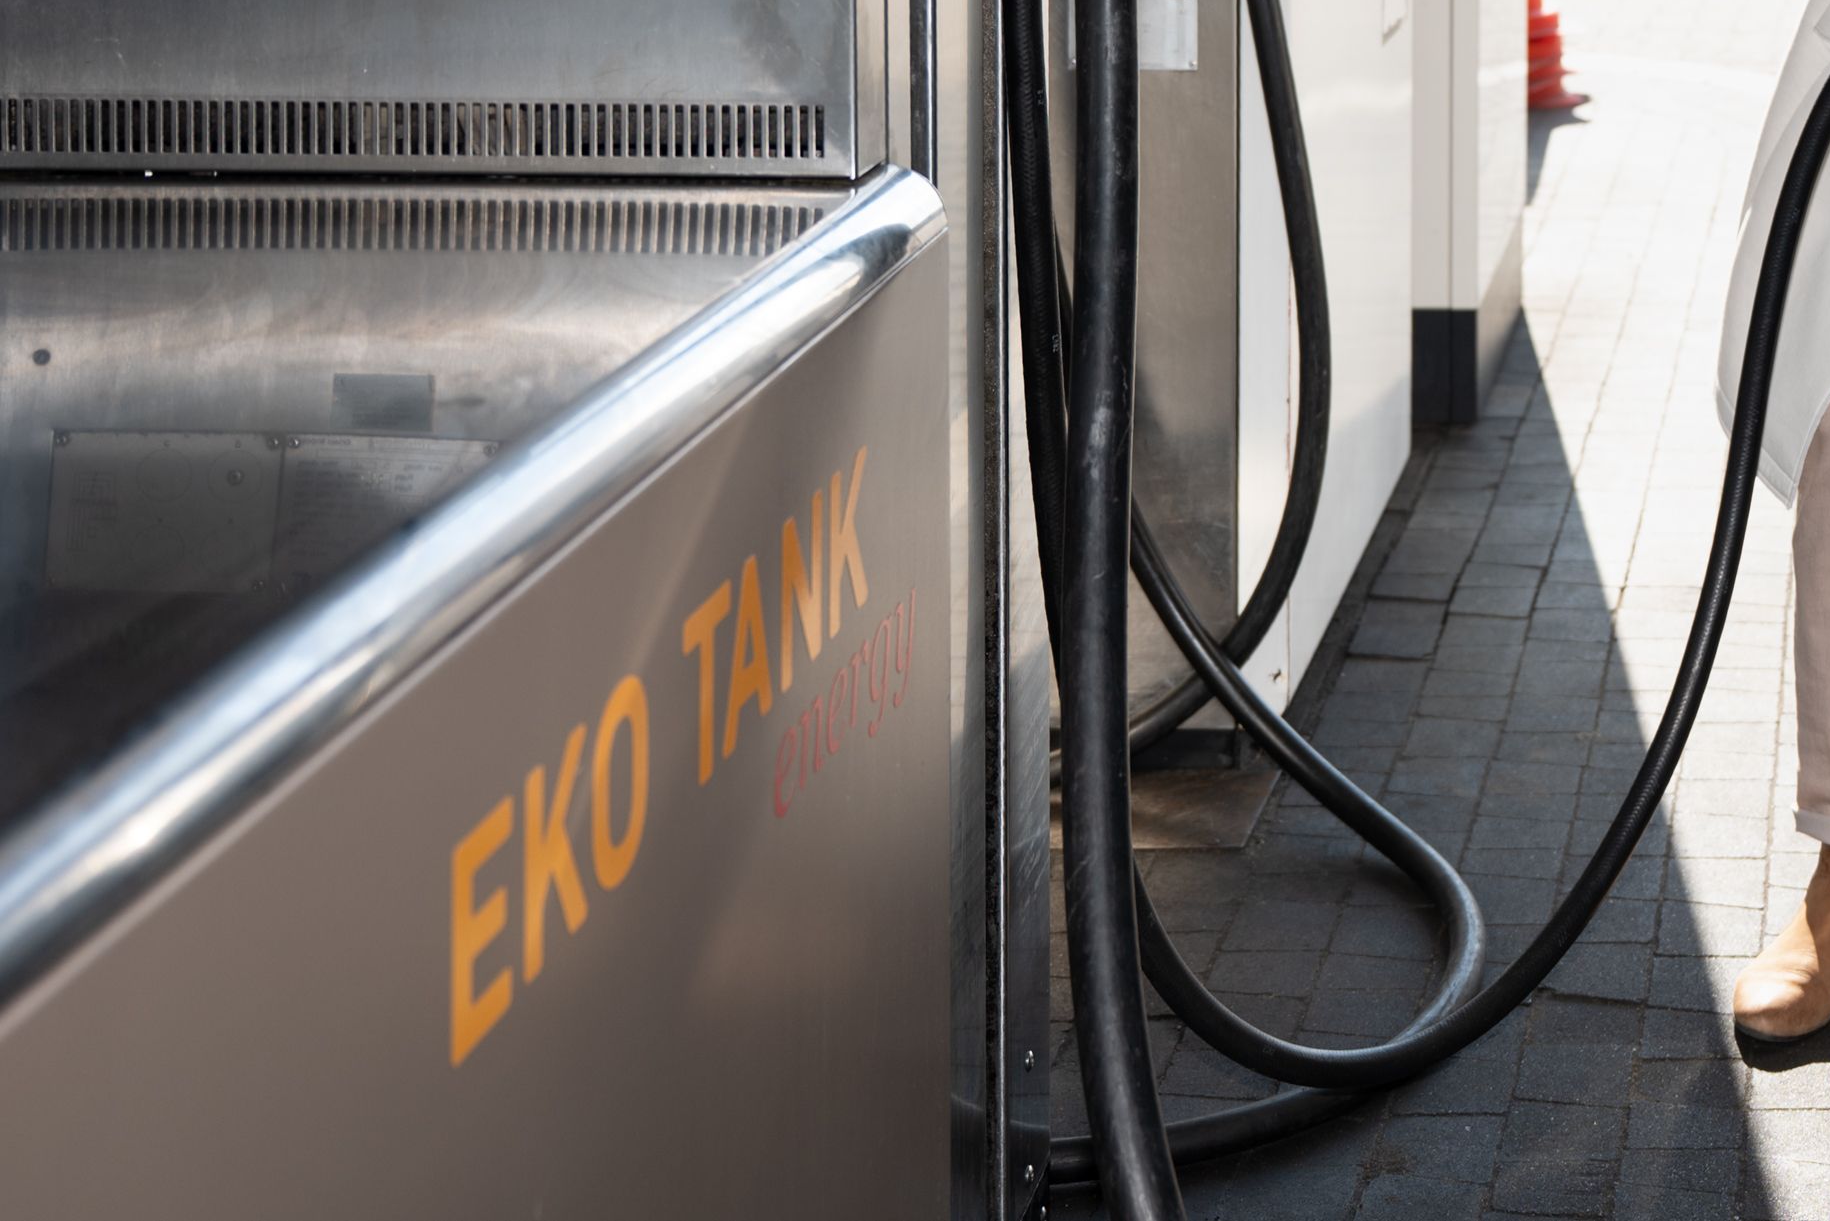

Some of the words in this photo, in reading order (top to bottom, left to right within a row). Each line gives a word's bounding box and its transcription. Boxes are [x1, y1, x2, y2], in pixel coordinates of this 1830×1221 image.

[450, 673, 650, 1068] EKO
[683, 443, 868, 786] TANK
[773, 588, 916, 819] energy
